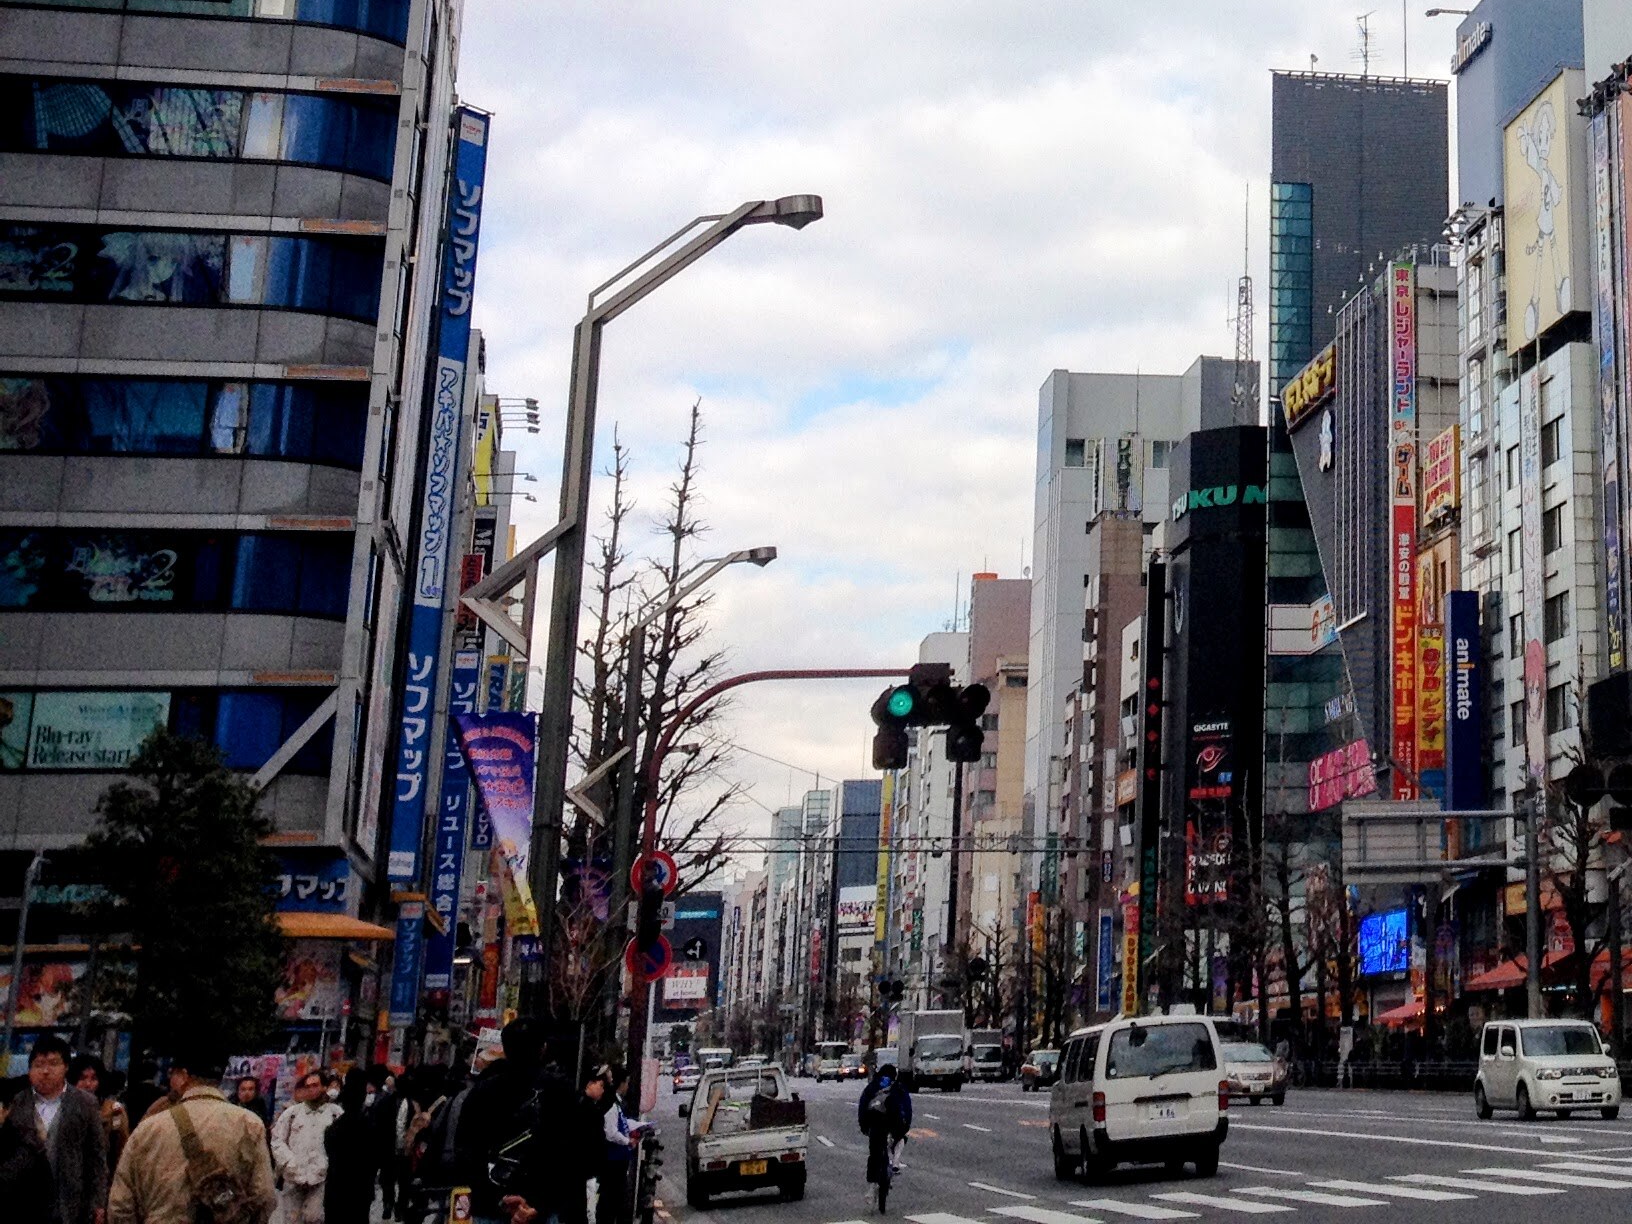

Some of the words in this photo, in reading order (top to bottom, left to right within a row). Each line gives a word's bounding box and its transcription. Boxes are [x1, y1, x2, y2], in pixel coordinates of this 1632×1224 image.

[1456, 638, 1474, 720] animate
[35, 725, 93, 751] Blu-ray
[396, 651, 434, 802] ソフマップ
